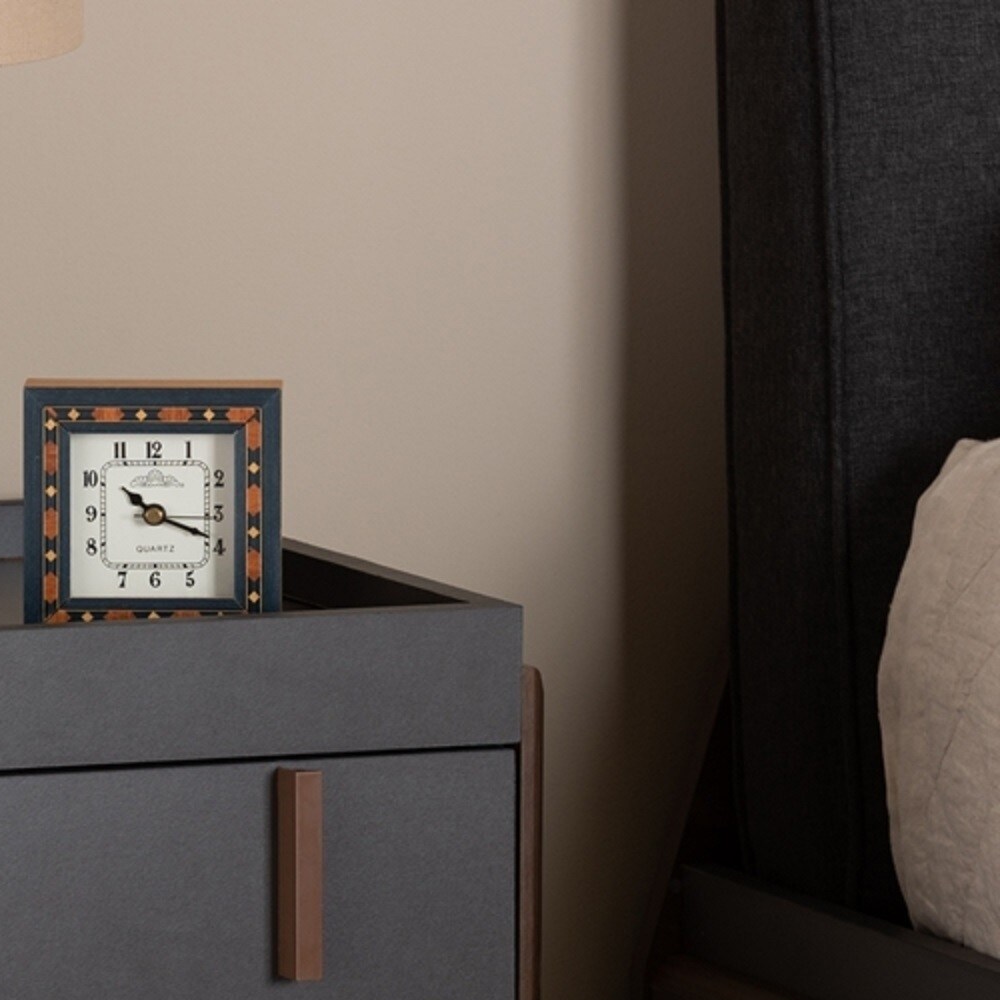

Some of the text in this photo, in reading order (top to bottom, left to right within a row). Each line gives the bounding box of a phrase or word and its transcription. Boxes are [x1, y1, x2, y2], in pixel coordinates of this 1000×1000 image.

[113, 441, 191, 459] 11 12 1
[83, 470, 225, 488] 10 2
[85, 505, 224, 522] 9 3
[86, 538, 226, 556] 8 4
[136, 545, 175, 554] QUARTZ
[117, 570, 195, 588] 7 6 5
